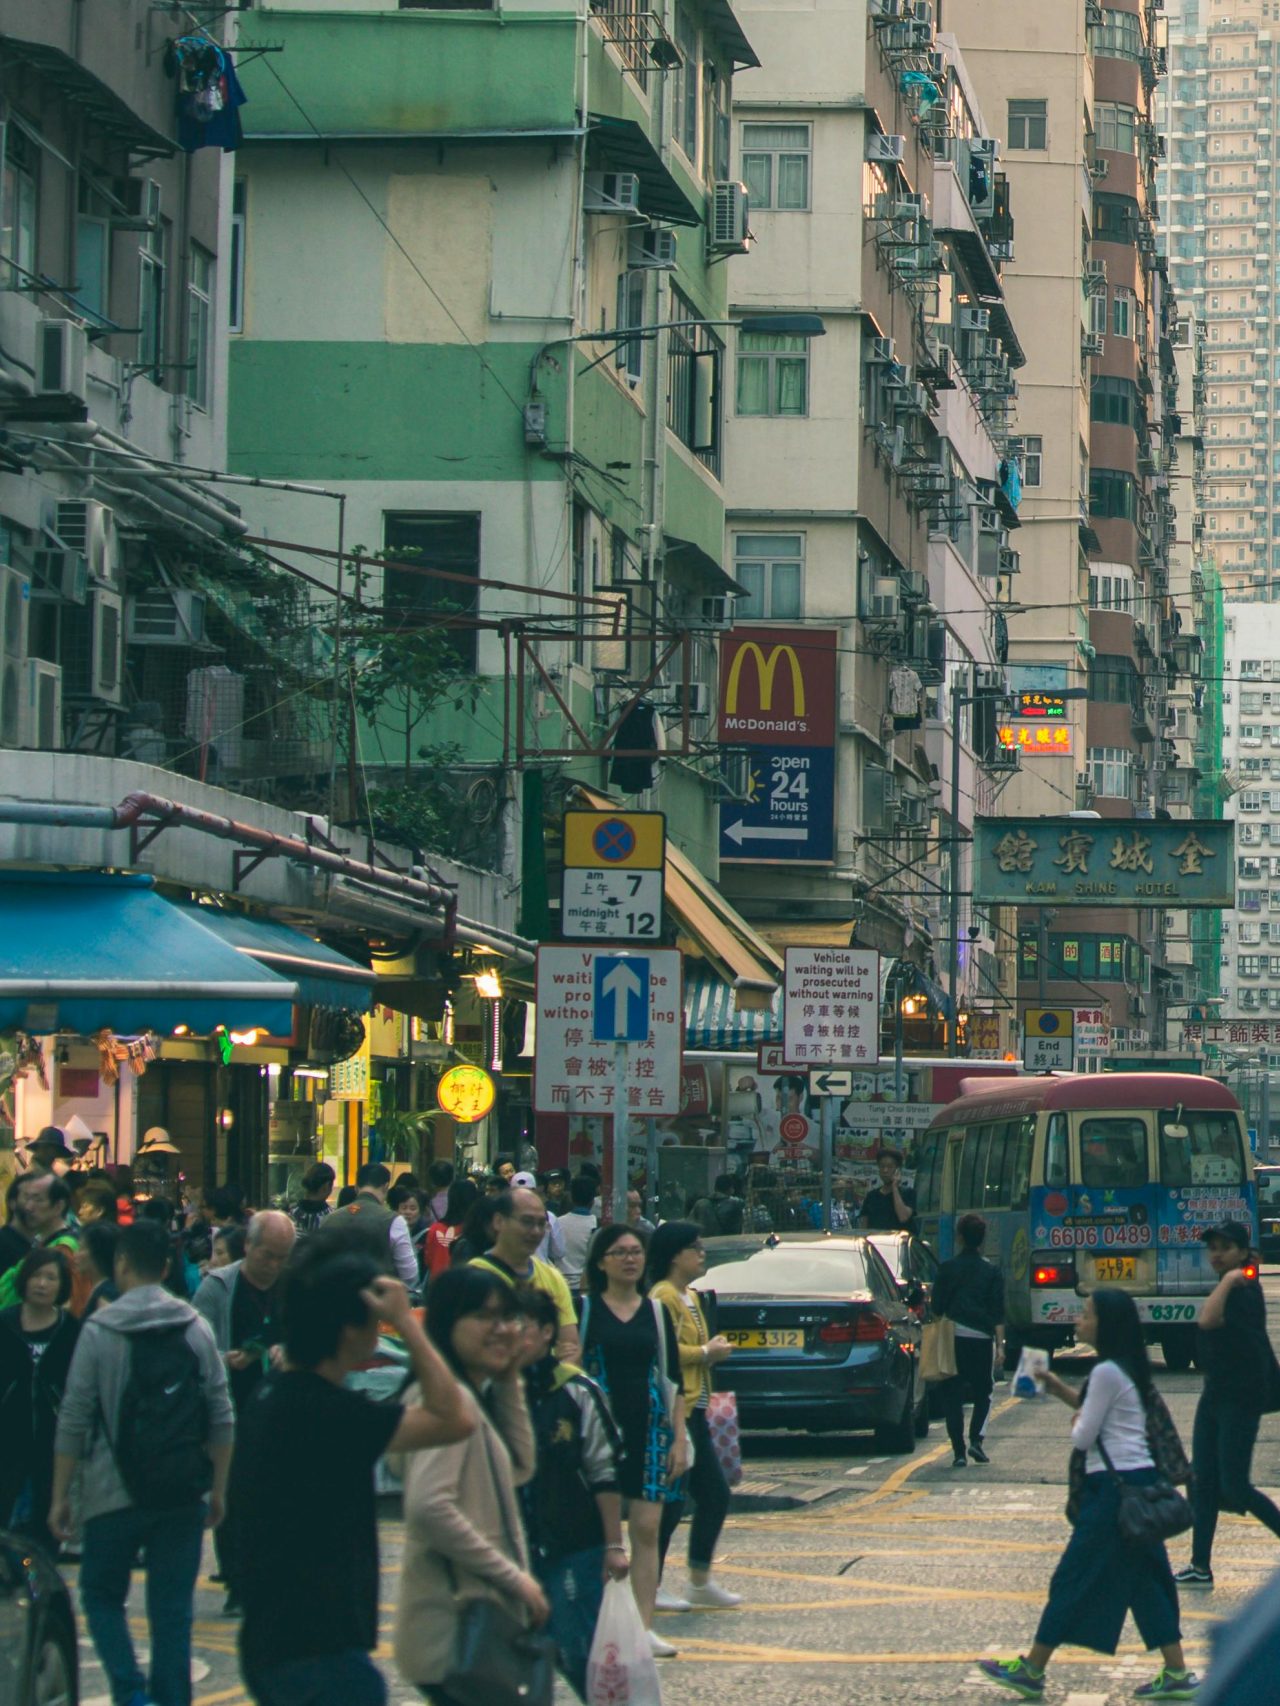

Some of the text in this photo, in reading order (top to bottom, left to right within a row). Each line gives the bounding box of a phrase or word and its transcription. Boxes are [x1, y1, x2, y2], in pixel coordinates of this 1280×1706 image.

[725, 717, 807, 732] McDonald's
[771, 756, 810, 771] open
[770, 772, 809, 799] 24
[770, 799, 809, 812] hours
[586, 871, 604, 880] am
[581, 883, 609, 896] 上午
[627, 876, 642, 896] 7
[1025, 881, 1179, 896] KAM SHING HOTEL
[568, 907, 619, 921] midnight
[579, 920, 607, 933] 午夜
[626, 913, 655, 934] 12
[814, 953, 850, 963] Vehicle
[795, 965, 869, 976] waiting will be
[803, 978, 860, 988] prosecuted
[789, 989, 873, 1001] without warning
[803, 1004, 860, 1018] 停車等候
[803, 1024, 860, 1038] 會被檢控
[795, 1044, 867, 1057] 而不予警告
[1038, 1041, 1060, 1050] End
[1034, 1054, 1063, 1066] 終止
[564, 1056, 655, 1078] 會被控
[869, 1105, 885, 1114] Tung
[906, 1105, 929, 1113] Street
[1051, 1225, 1150, 1246] 6606 0489
[1106, 1258, 1124, 1268] LB
[1098, 1268, 1133, 1279] 7174
[1152, 1304, 1195, 1320] 6370
[727, 1331, 798, 1345] PP 3312
